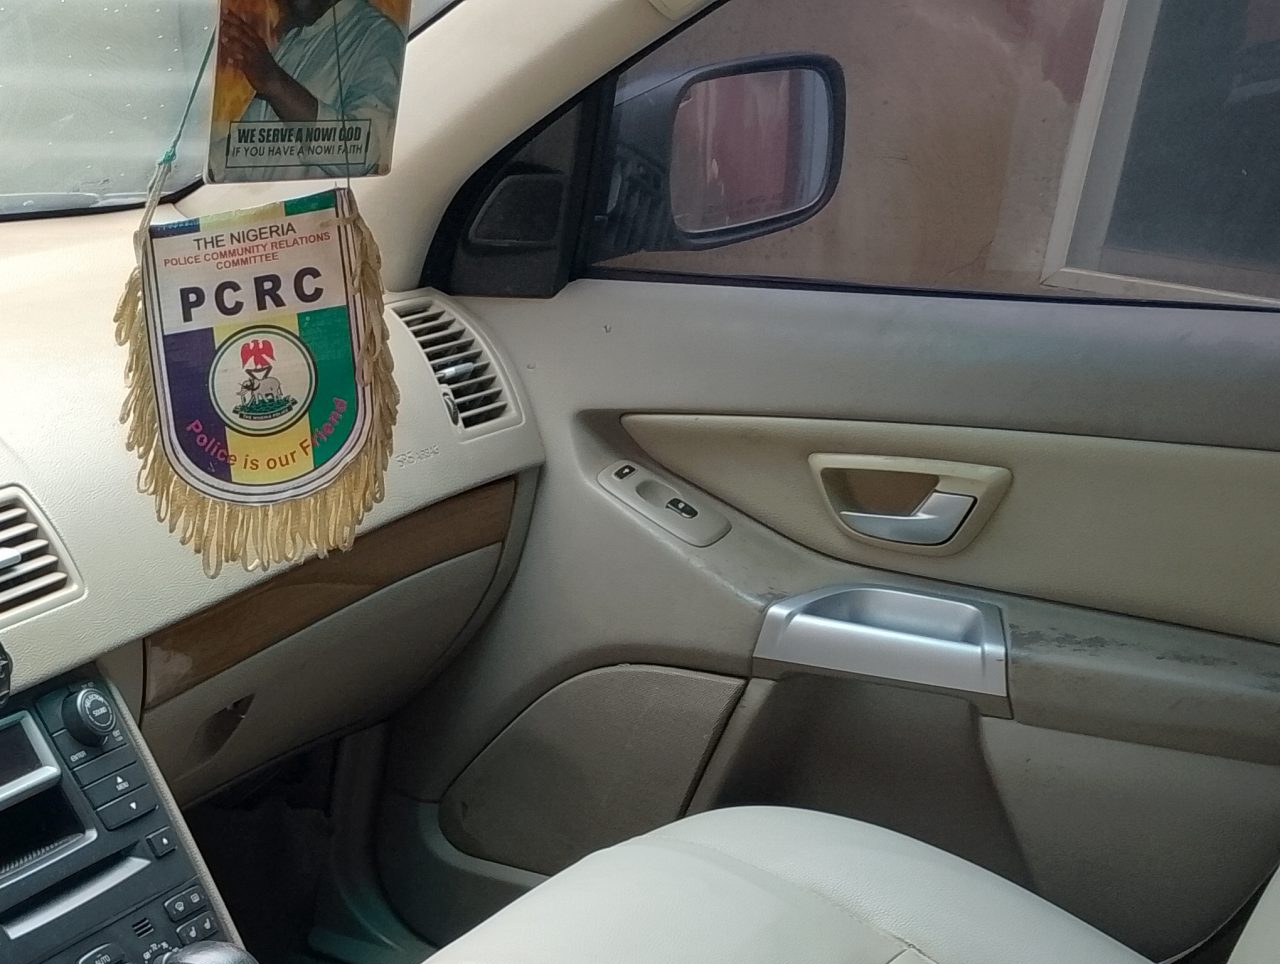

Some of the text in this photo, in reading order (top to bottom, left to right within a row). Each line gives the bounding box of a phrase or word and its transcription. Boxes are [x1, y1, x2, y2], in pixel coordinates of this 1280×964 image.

[238, 128, 256, 143] WE
[258, 127, 296, 143] SERVE
[295, 127, 303, 142] A
[306, 126, 336, 142] NOW!
[232, 143, 363, 157] IF YOU HAVE A NOW! FAITH
[193, 222, 297, 250] THE NIGERIA
[163, 231, 331, 267] POLICE COMMUNITY RELATIONS
[216, 251, 279, 270] COMMITTEE
[186, 397, 347, 471] Police is our Friend
